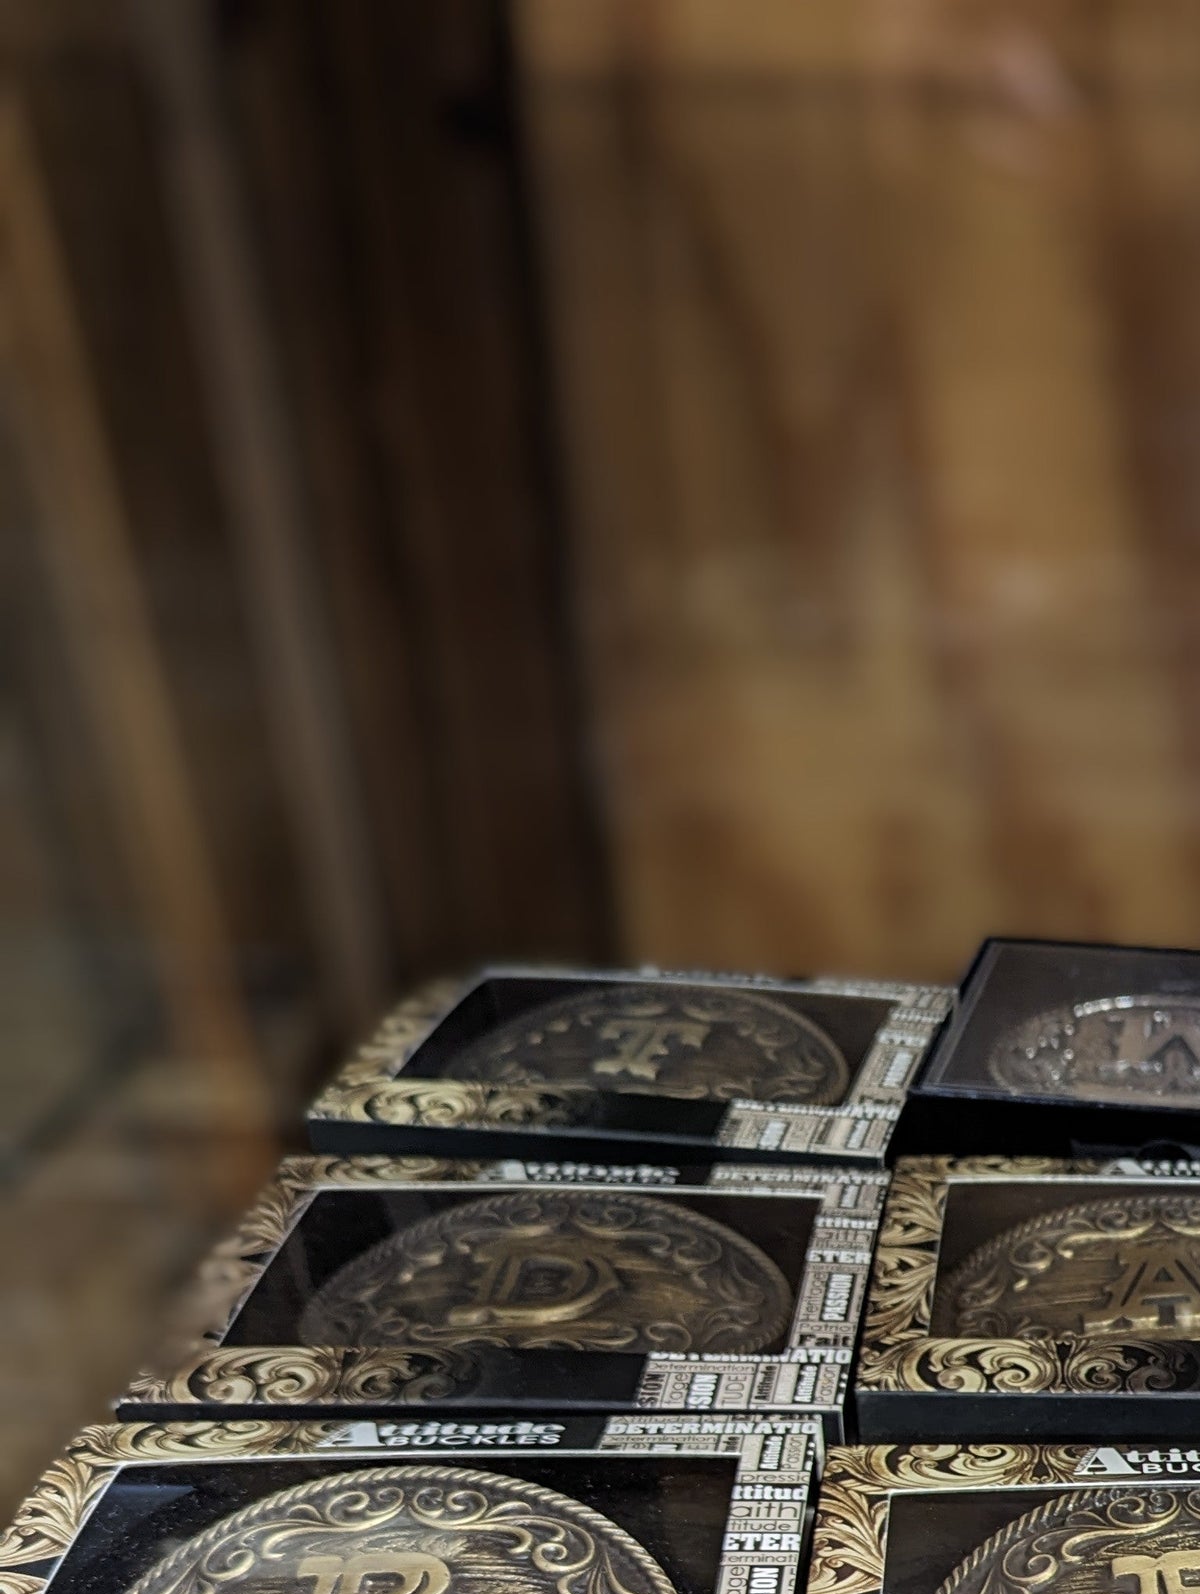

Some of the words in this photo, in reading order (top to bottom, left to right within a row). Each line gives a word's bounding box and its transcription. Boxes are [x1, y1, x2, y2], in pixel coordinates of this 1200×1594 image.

[822, 1274, 854, 1321] PASSION
[314, 1420, 567, 1448] Attitude
[606, 1422, 817, 1434] DETERMINATIO
[388, 1434, 562, 1446] BUCKLES
[724, 1533, 801, 1551] ETER
